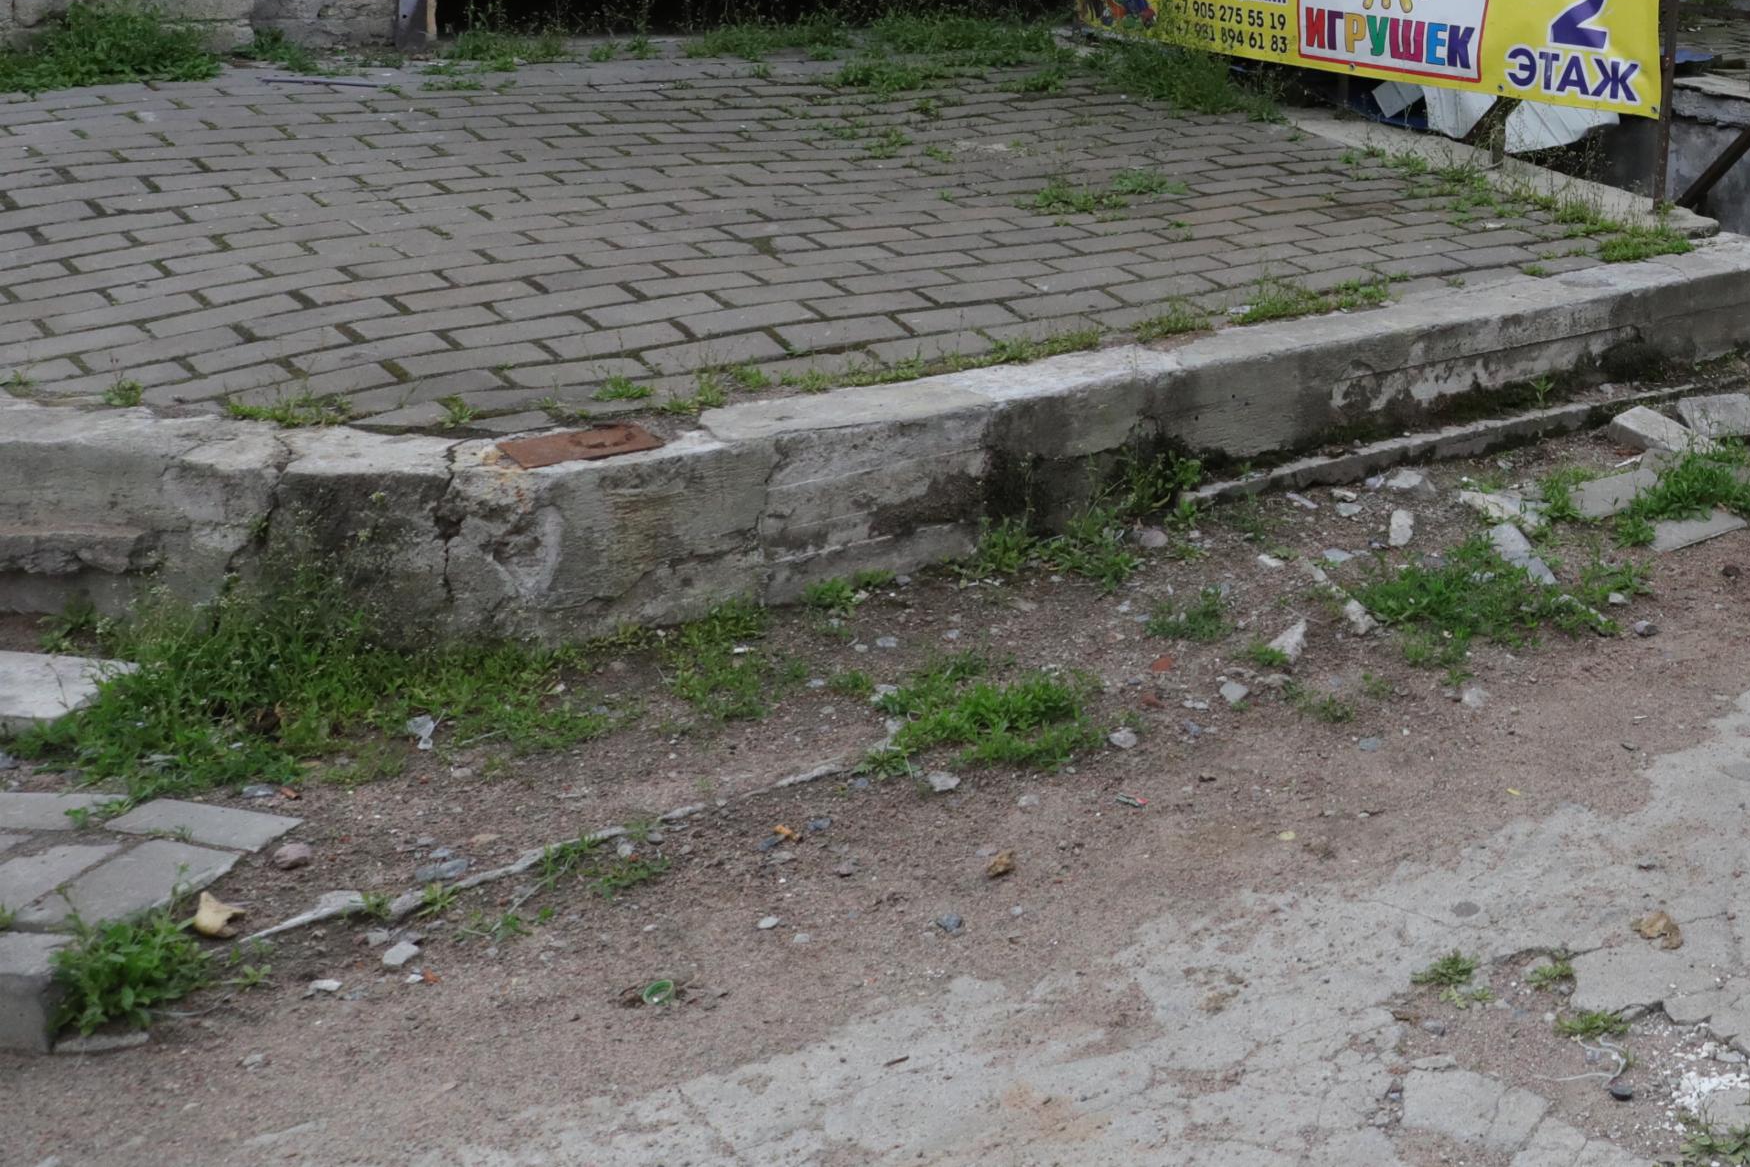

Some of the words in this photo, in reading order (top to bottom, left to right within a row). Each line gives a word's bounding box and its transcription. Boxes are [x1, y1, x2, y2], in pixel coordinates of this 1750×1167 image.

[1192, 0, 1216, 20] 905
[1219, 5, 1243, 24] 275
[1248, 9, 1264, 28] 55
[1269, 12, 1287, 31] 19
[1220, 27, 1244, 48] 894
[1249, 32, 1265, 50] 61
[1270, 35, 1288, 53] 83
[1305, 6, 1475, 69] ИГРУШЕК
[1507, 47, 1640, 102] ЭТАЖ
